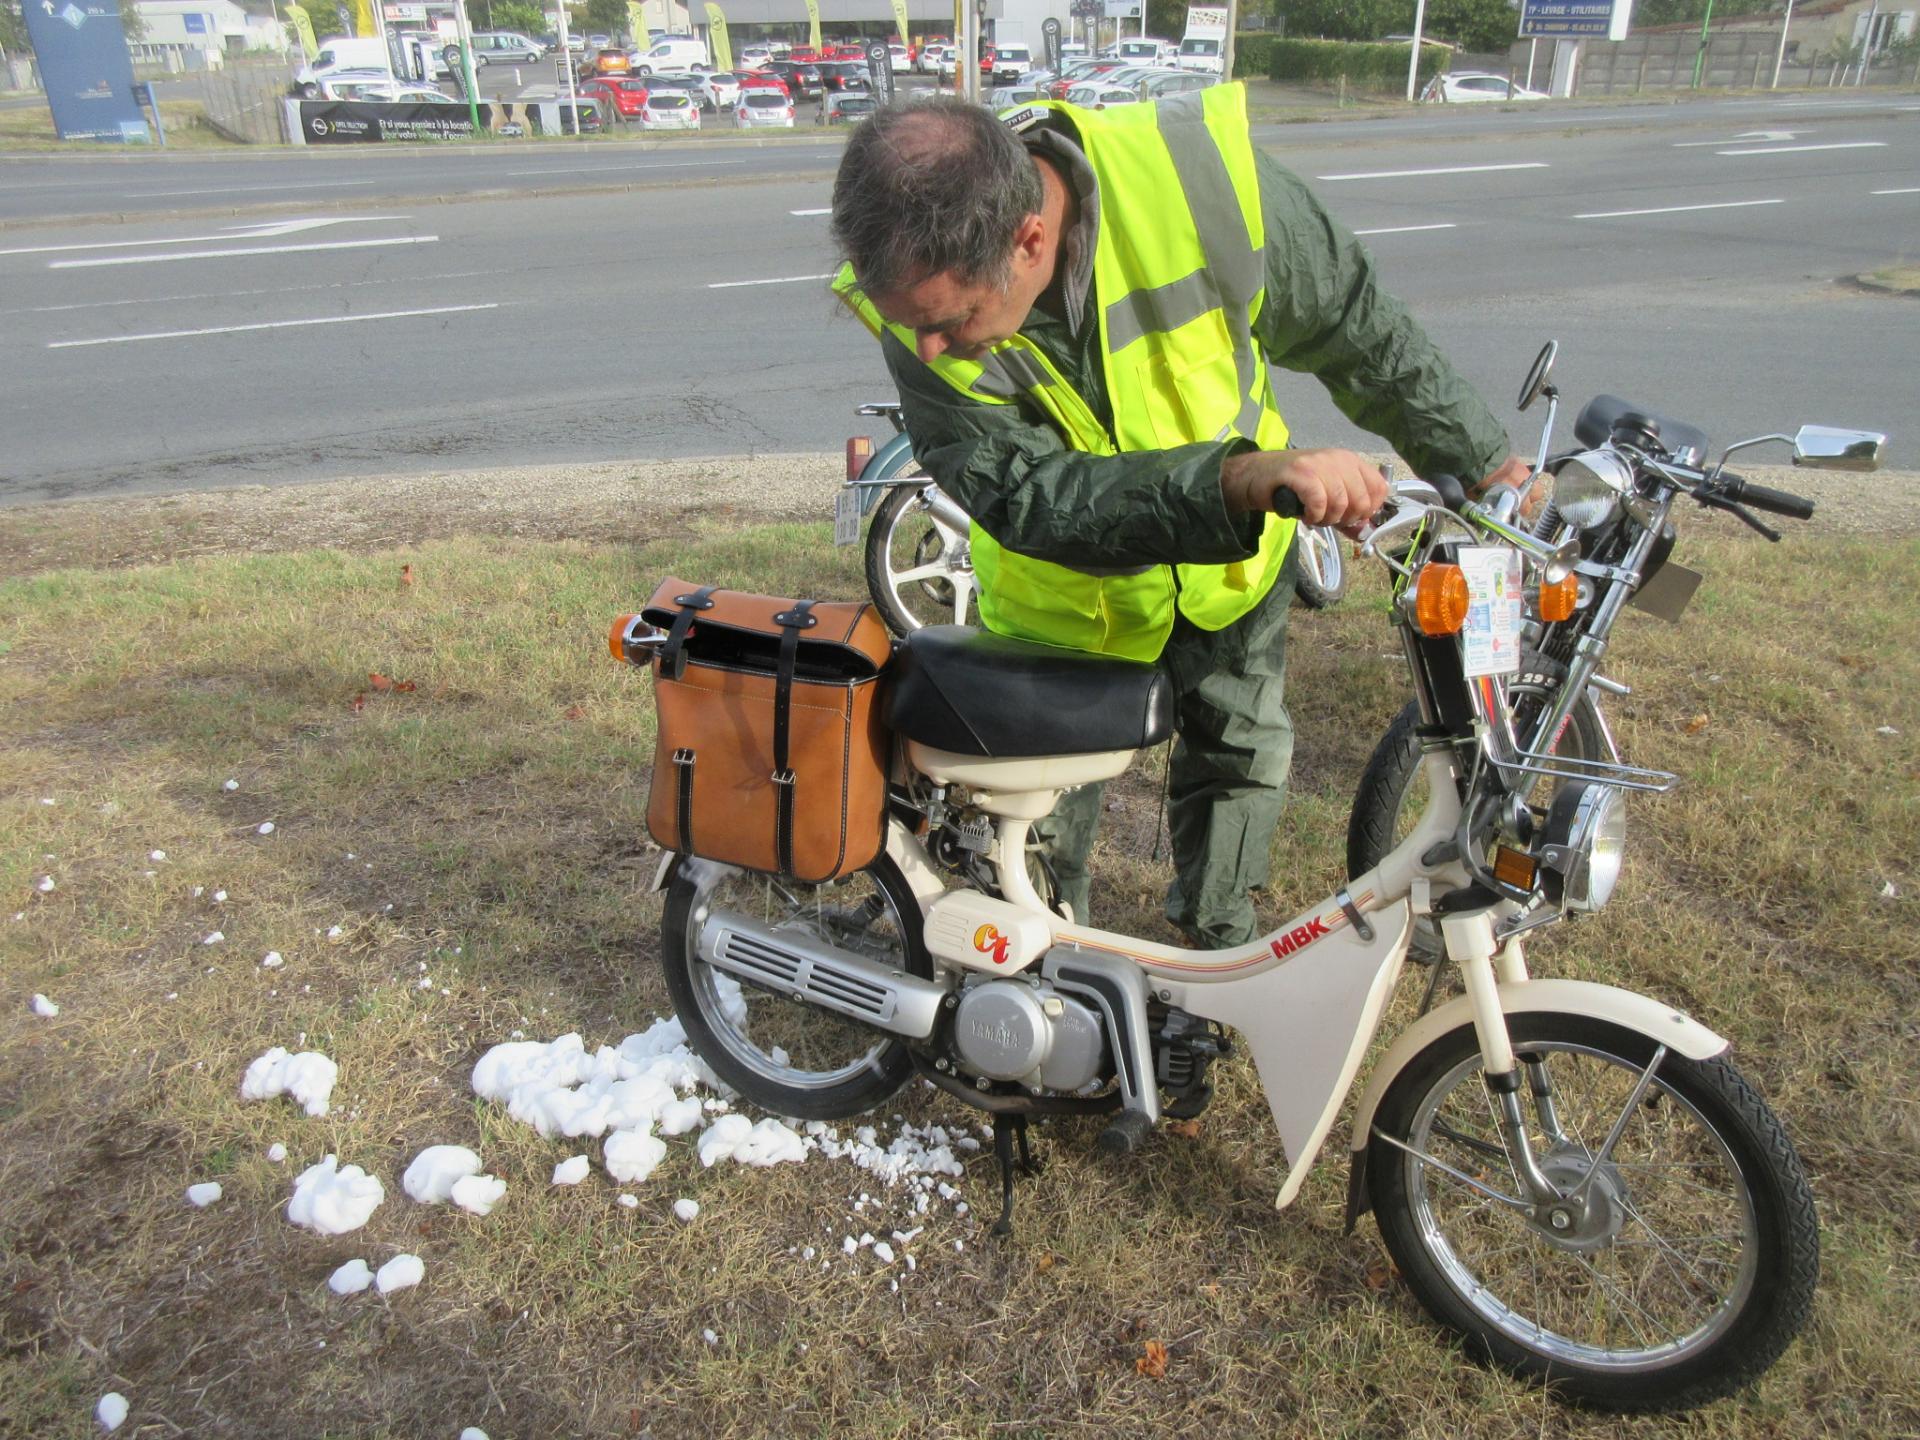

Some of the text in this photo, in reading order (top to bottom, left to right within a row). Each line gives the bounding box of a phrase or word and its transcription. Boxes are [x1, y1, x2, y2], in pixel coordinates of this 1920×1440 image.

[1541, 6, 1565, 15] LEVAGE
[1570, 6, 1610, 15] UTILITAIRES
[379, 119, 386, 129] Et
[387, 119, 393, 129] si
[393, 121, 411, 129] vous
[411, 120, 435, 131] passiez
[442, 119, 449, 129] la
[450, 119, 473, 130] locatio
[399, 130, 417, 139] votre
[1269, 915, 1332, 959] MBK
[971, 1018, 1021, 1049] YAMAHA
